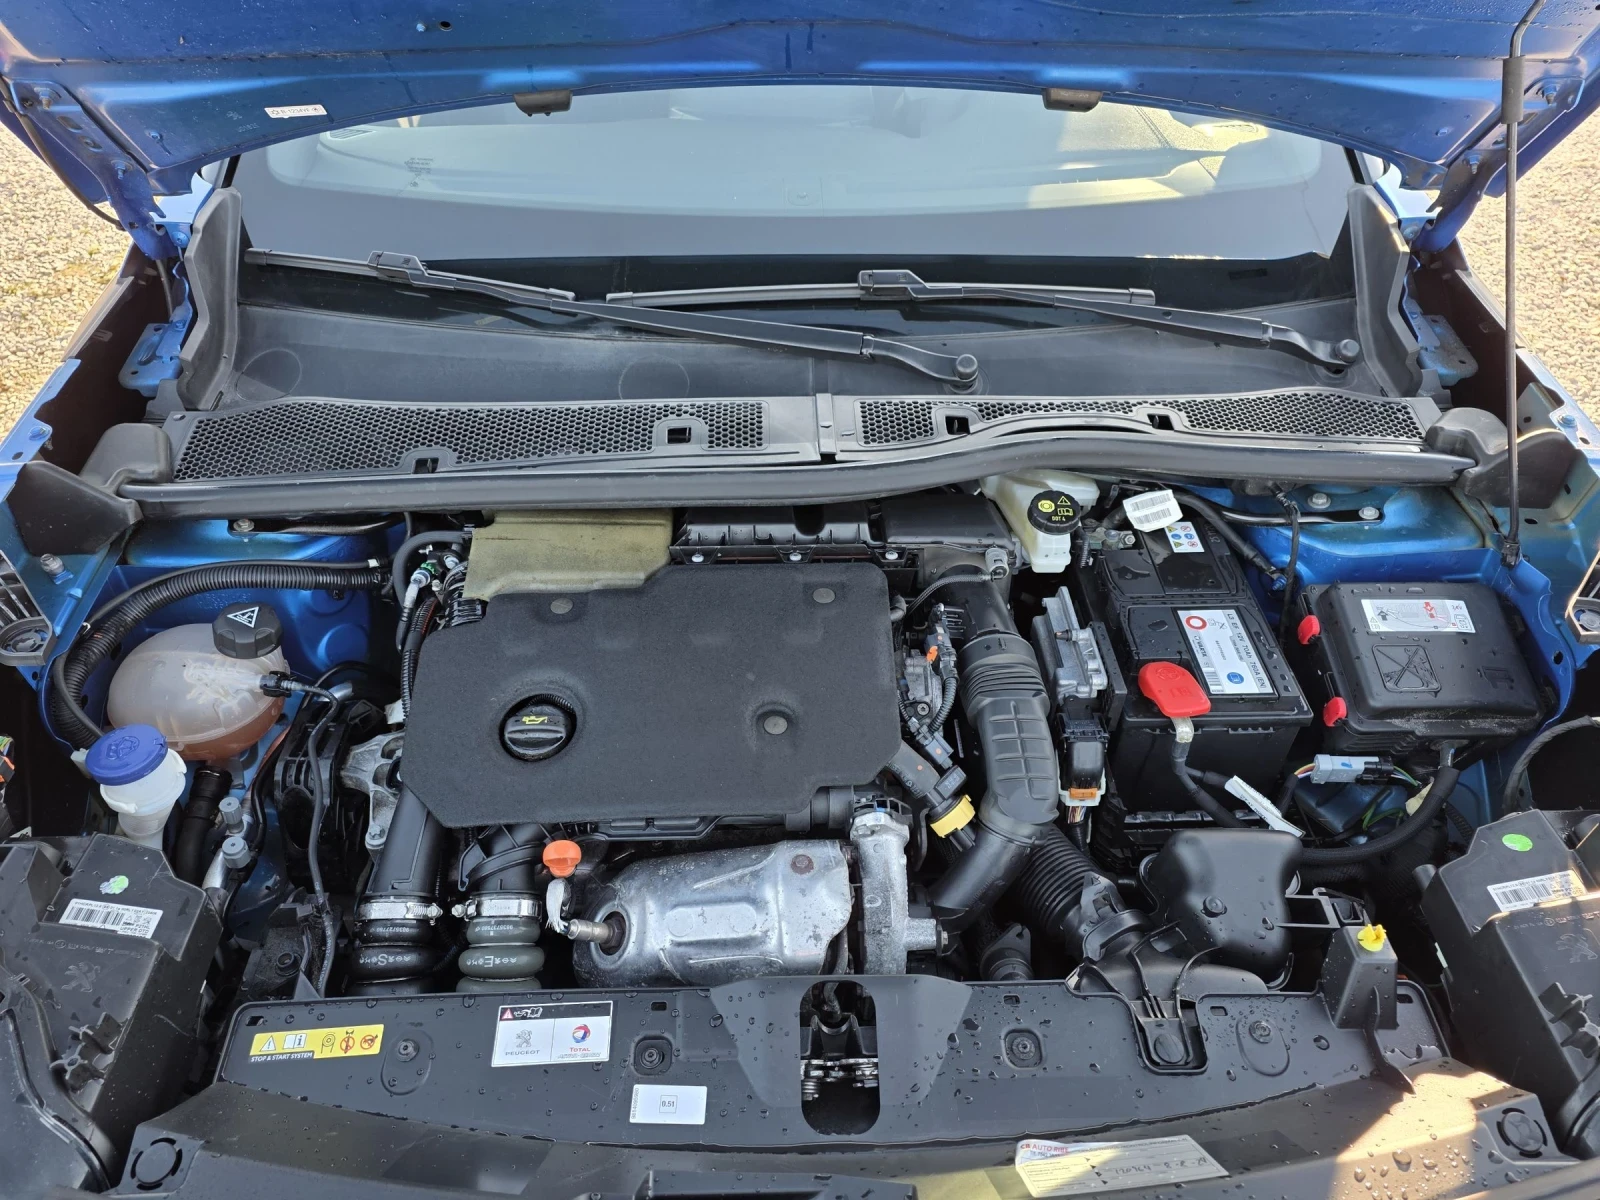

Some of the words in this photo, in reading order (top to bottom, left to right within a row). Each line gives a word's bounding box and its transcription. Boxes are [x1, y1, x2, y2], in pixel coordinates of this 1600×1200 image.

[1196, 640, 1207, 658] VARTA
[1242, 644, 1252, 658] 70Ah
[661, 1100, 675, 1108] 0.51
[1032, 1144, 1052, 1152] AUTO
